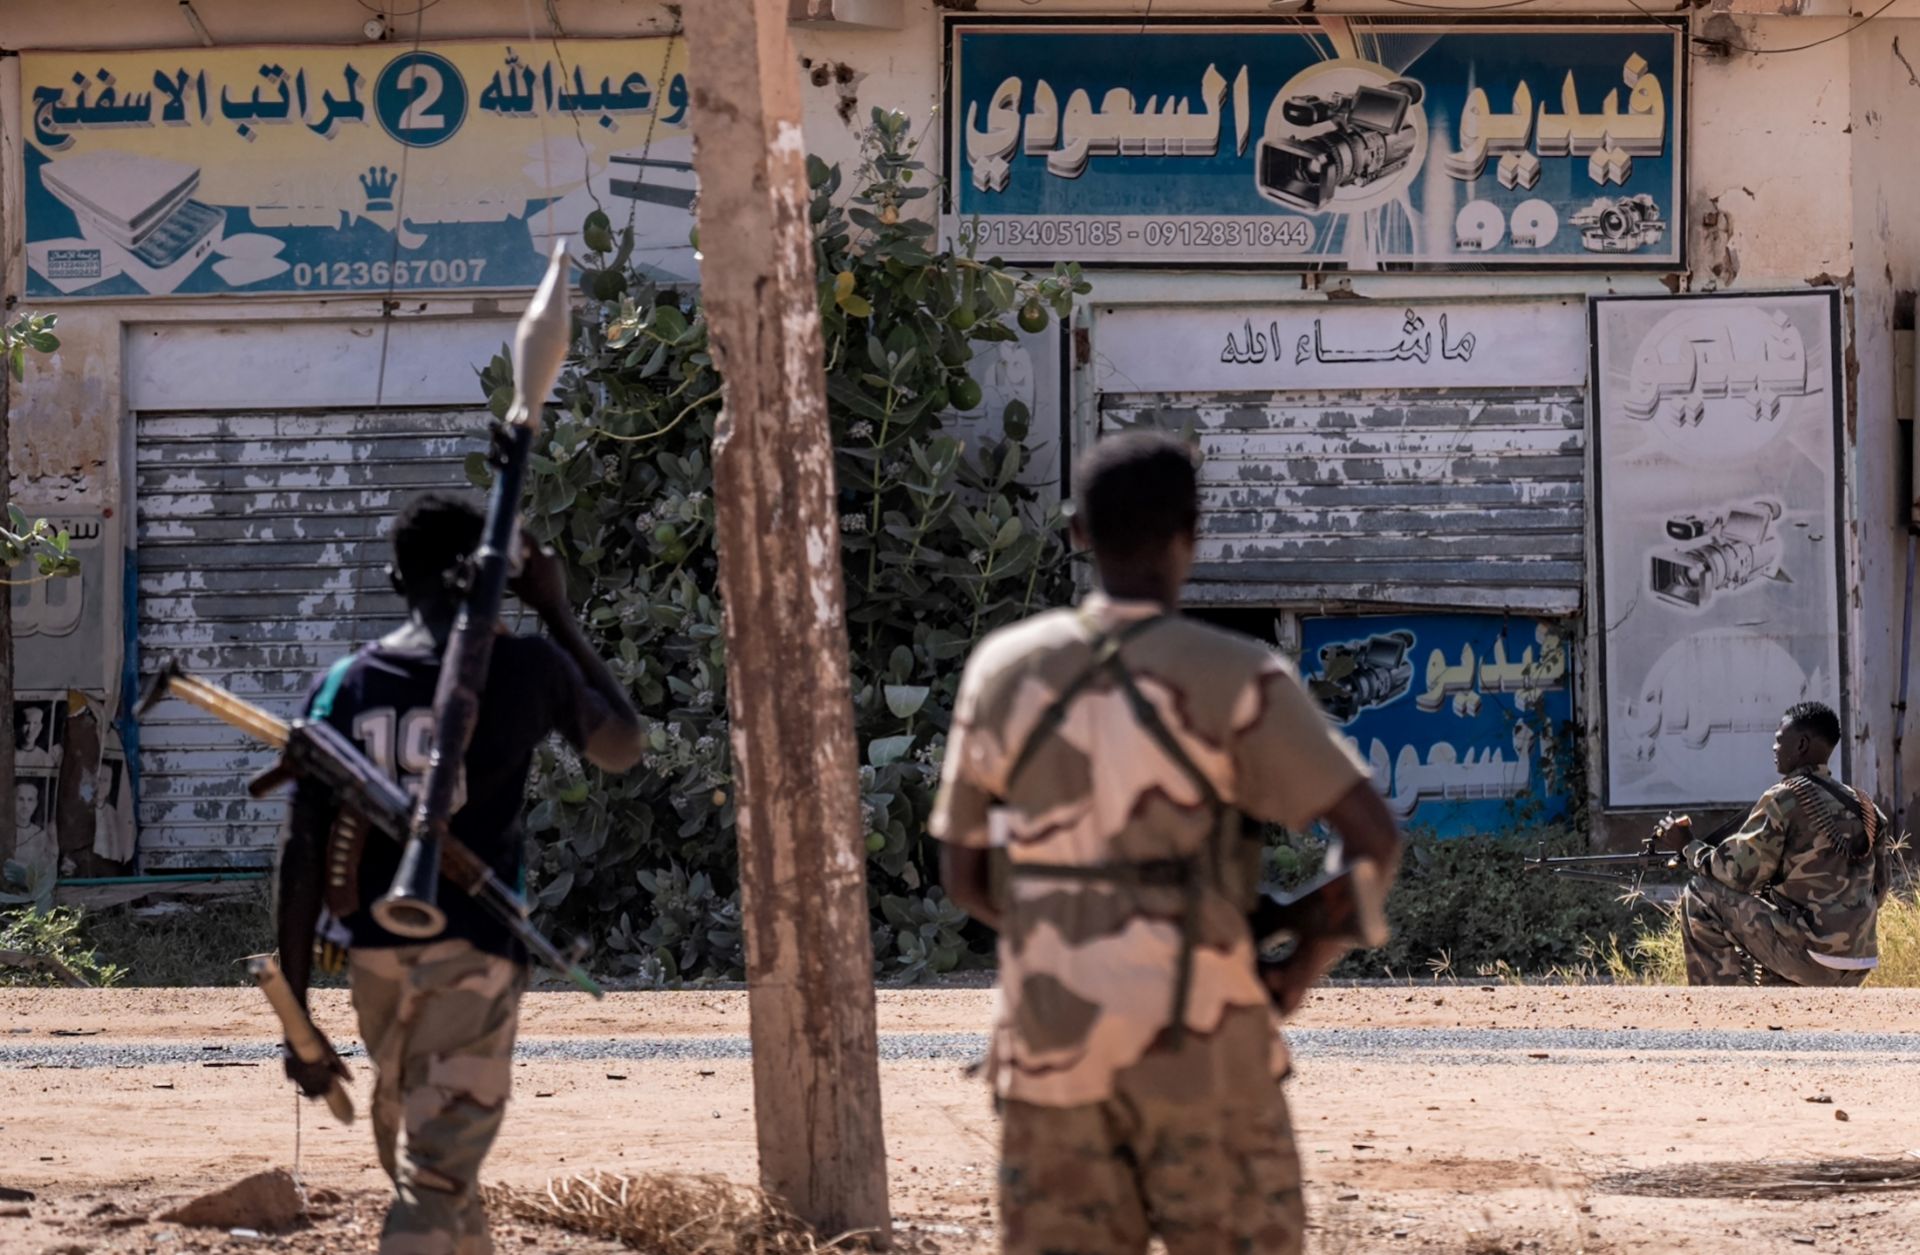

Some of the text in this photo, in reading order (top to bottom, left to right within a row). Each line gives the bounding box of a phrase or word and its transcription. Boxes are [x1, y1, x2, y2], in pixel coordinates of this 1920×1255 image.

[396, 63, 445, 129] 2
[965, 52, 1667, 193] فيديو السعودي
[293, 258, 487, 286] 0123667007
[959, 221, 1122, 246] 0913405185
[1144, 221, 1308, 246] 0912831844
[1416, 623, 1566, 718] فيديو
[1345, 717, 1556, 821] السعود
